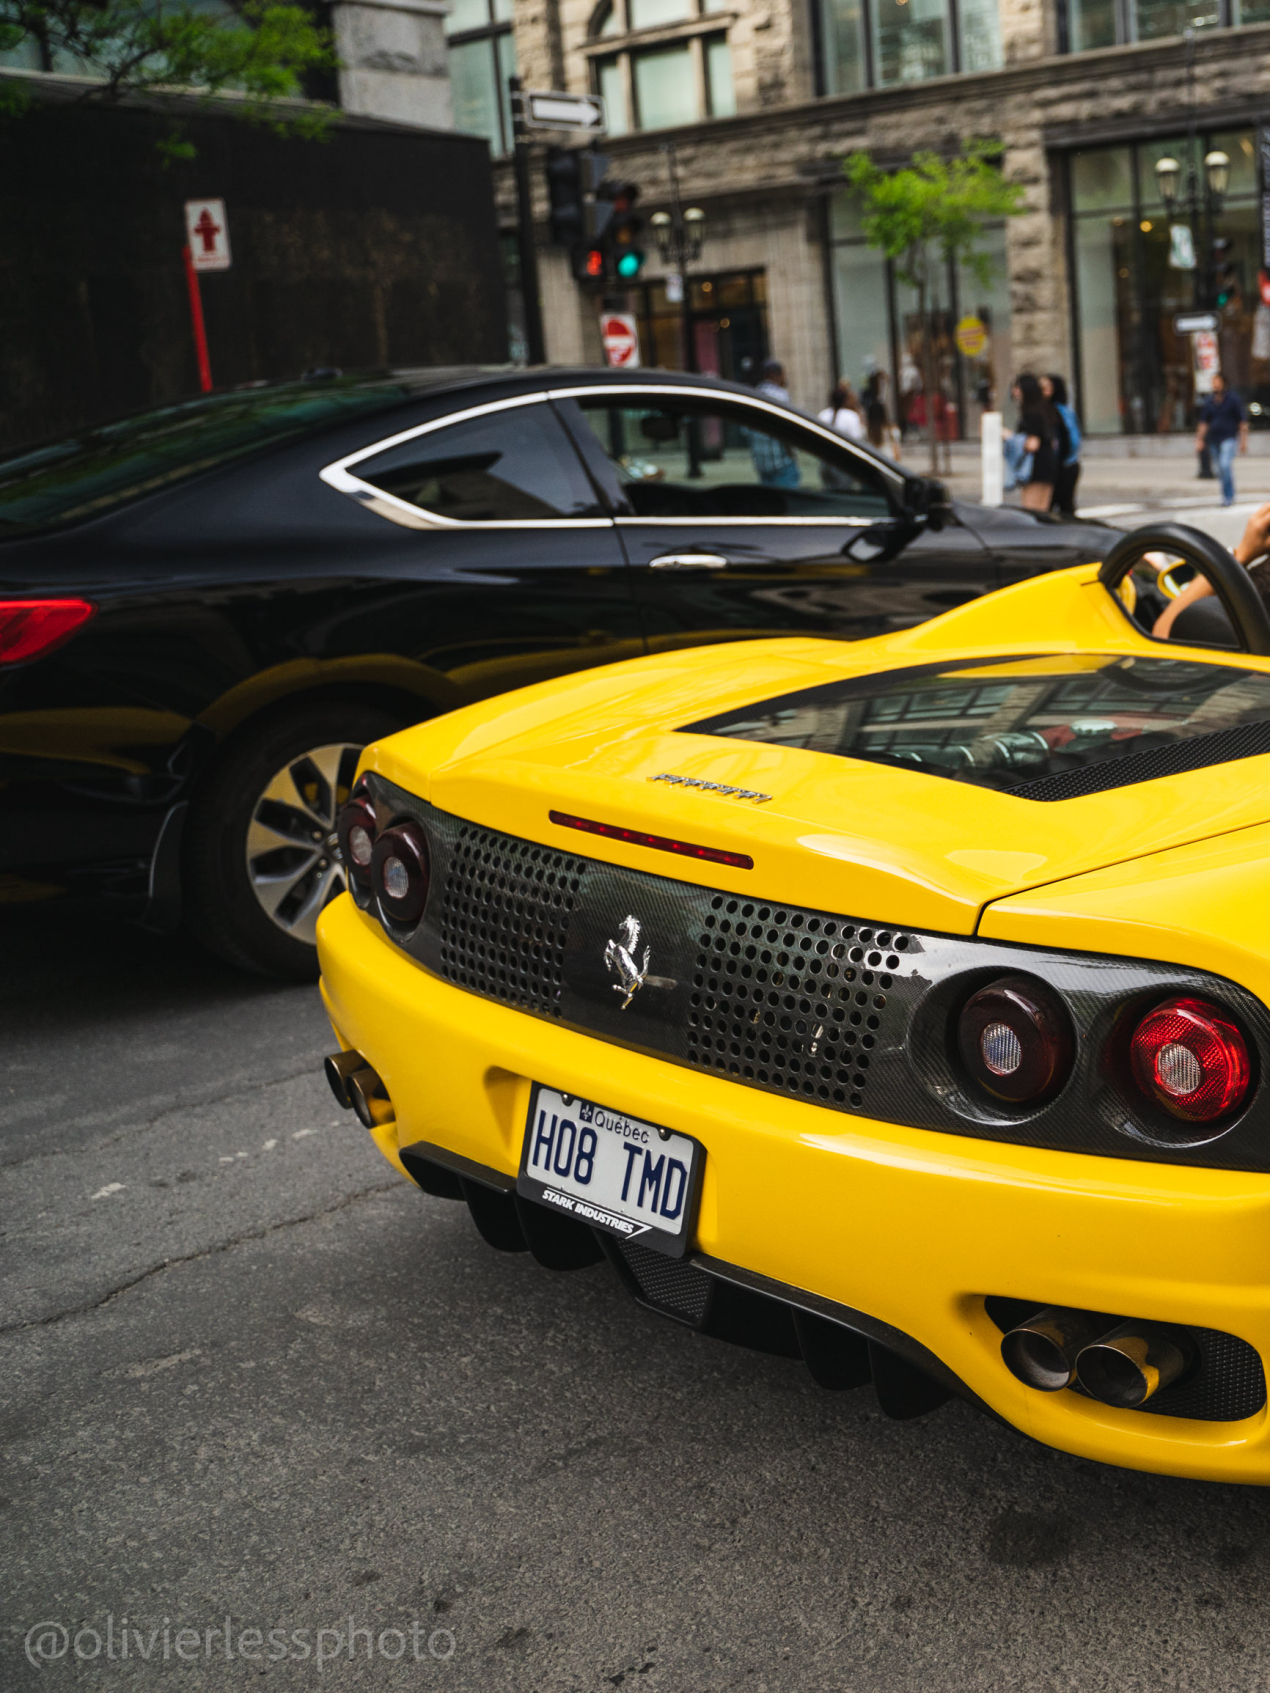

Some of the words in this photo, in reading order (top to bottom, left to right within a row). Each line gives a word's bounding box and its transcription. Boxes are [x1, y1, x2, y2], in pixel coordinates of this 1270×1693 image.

[594, 1107, 650, 1144] Québec
[532, 1109, 599, 1186] H08
[620, 1141, 688, 1220] TMD
[542, 1189, 575, 1211] STARK
[575, 1203, 635, 1235] INDUSTRIES
